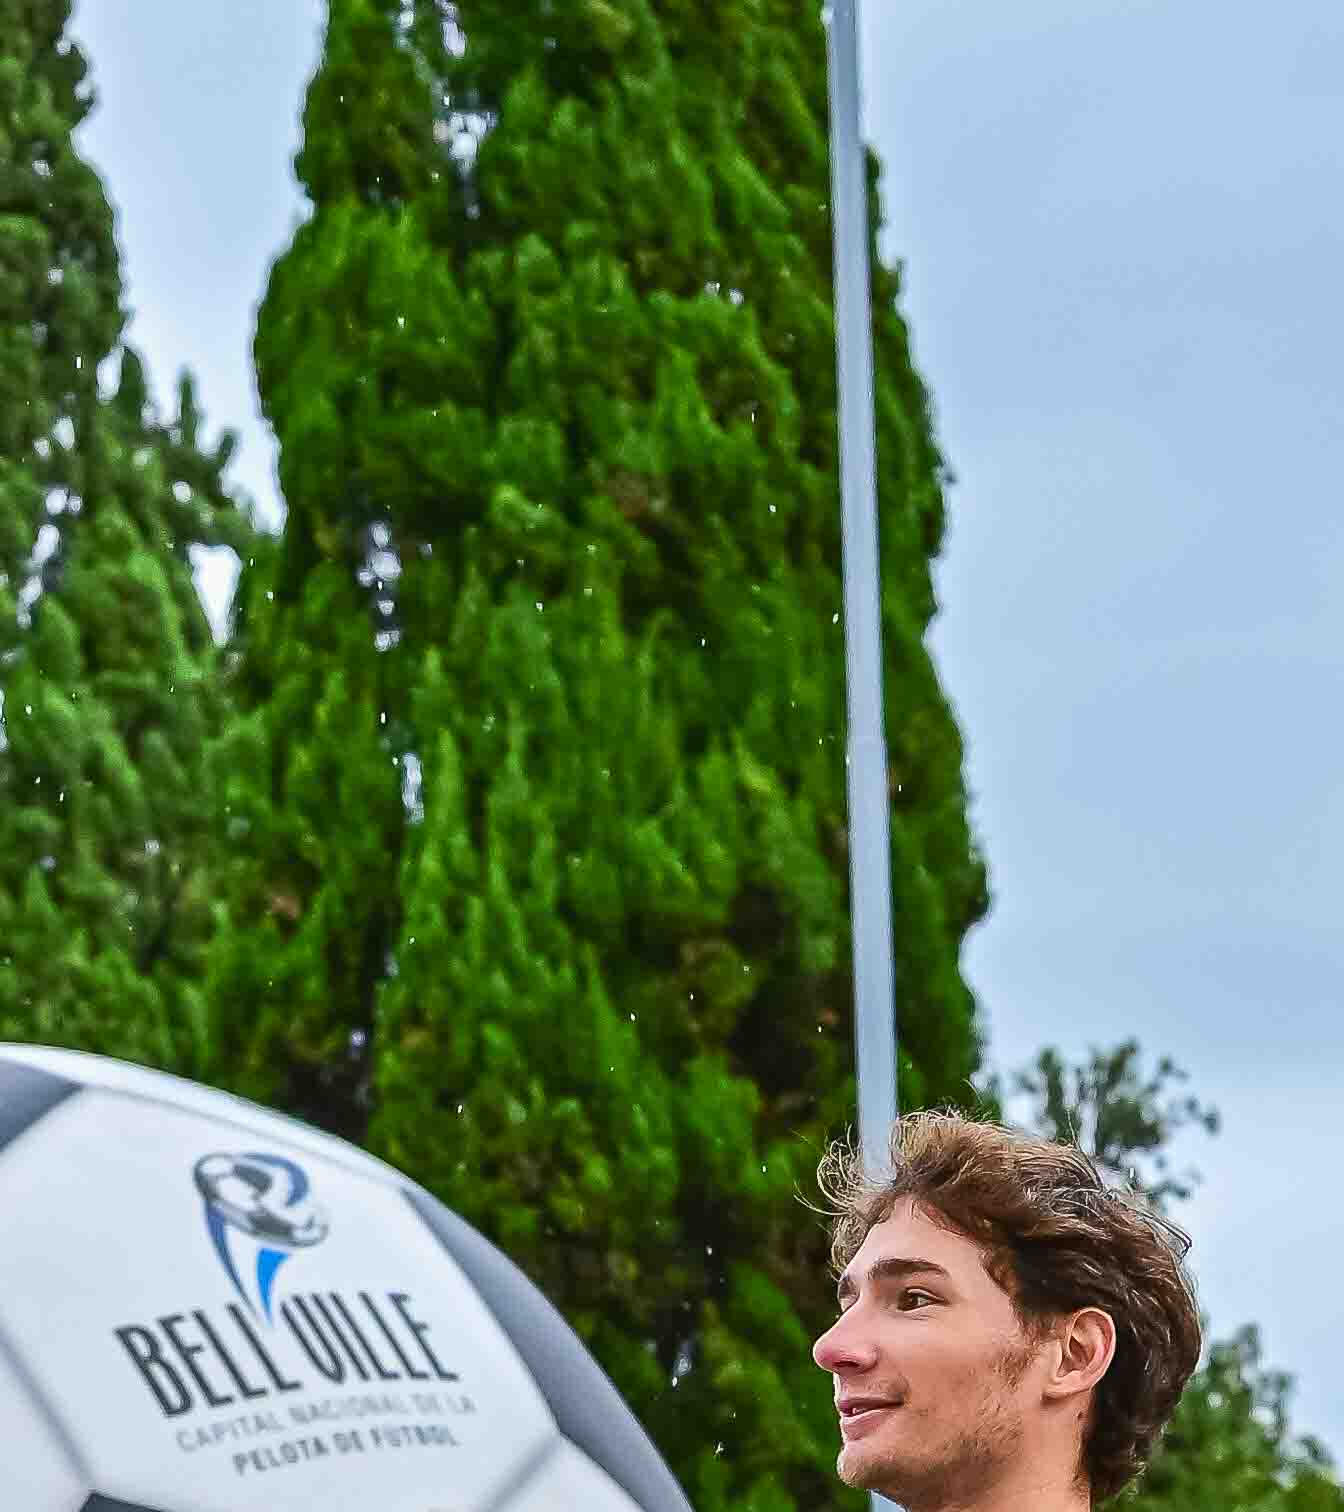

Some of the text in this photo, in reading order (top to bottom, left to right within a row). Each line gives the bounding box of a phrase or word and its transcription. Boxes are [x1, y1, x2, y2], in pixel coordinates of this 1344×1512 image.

[113, 1290, 459, 1418] BELL VILLE
[176, 1414, 284, 1451] CAPITAL
[233, 1435, 330, 1475] PELOTA
